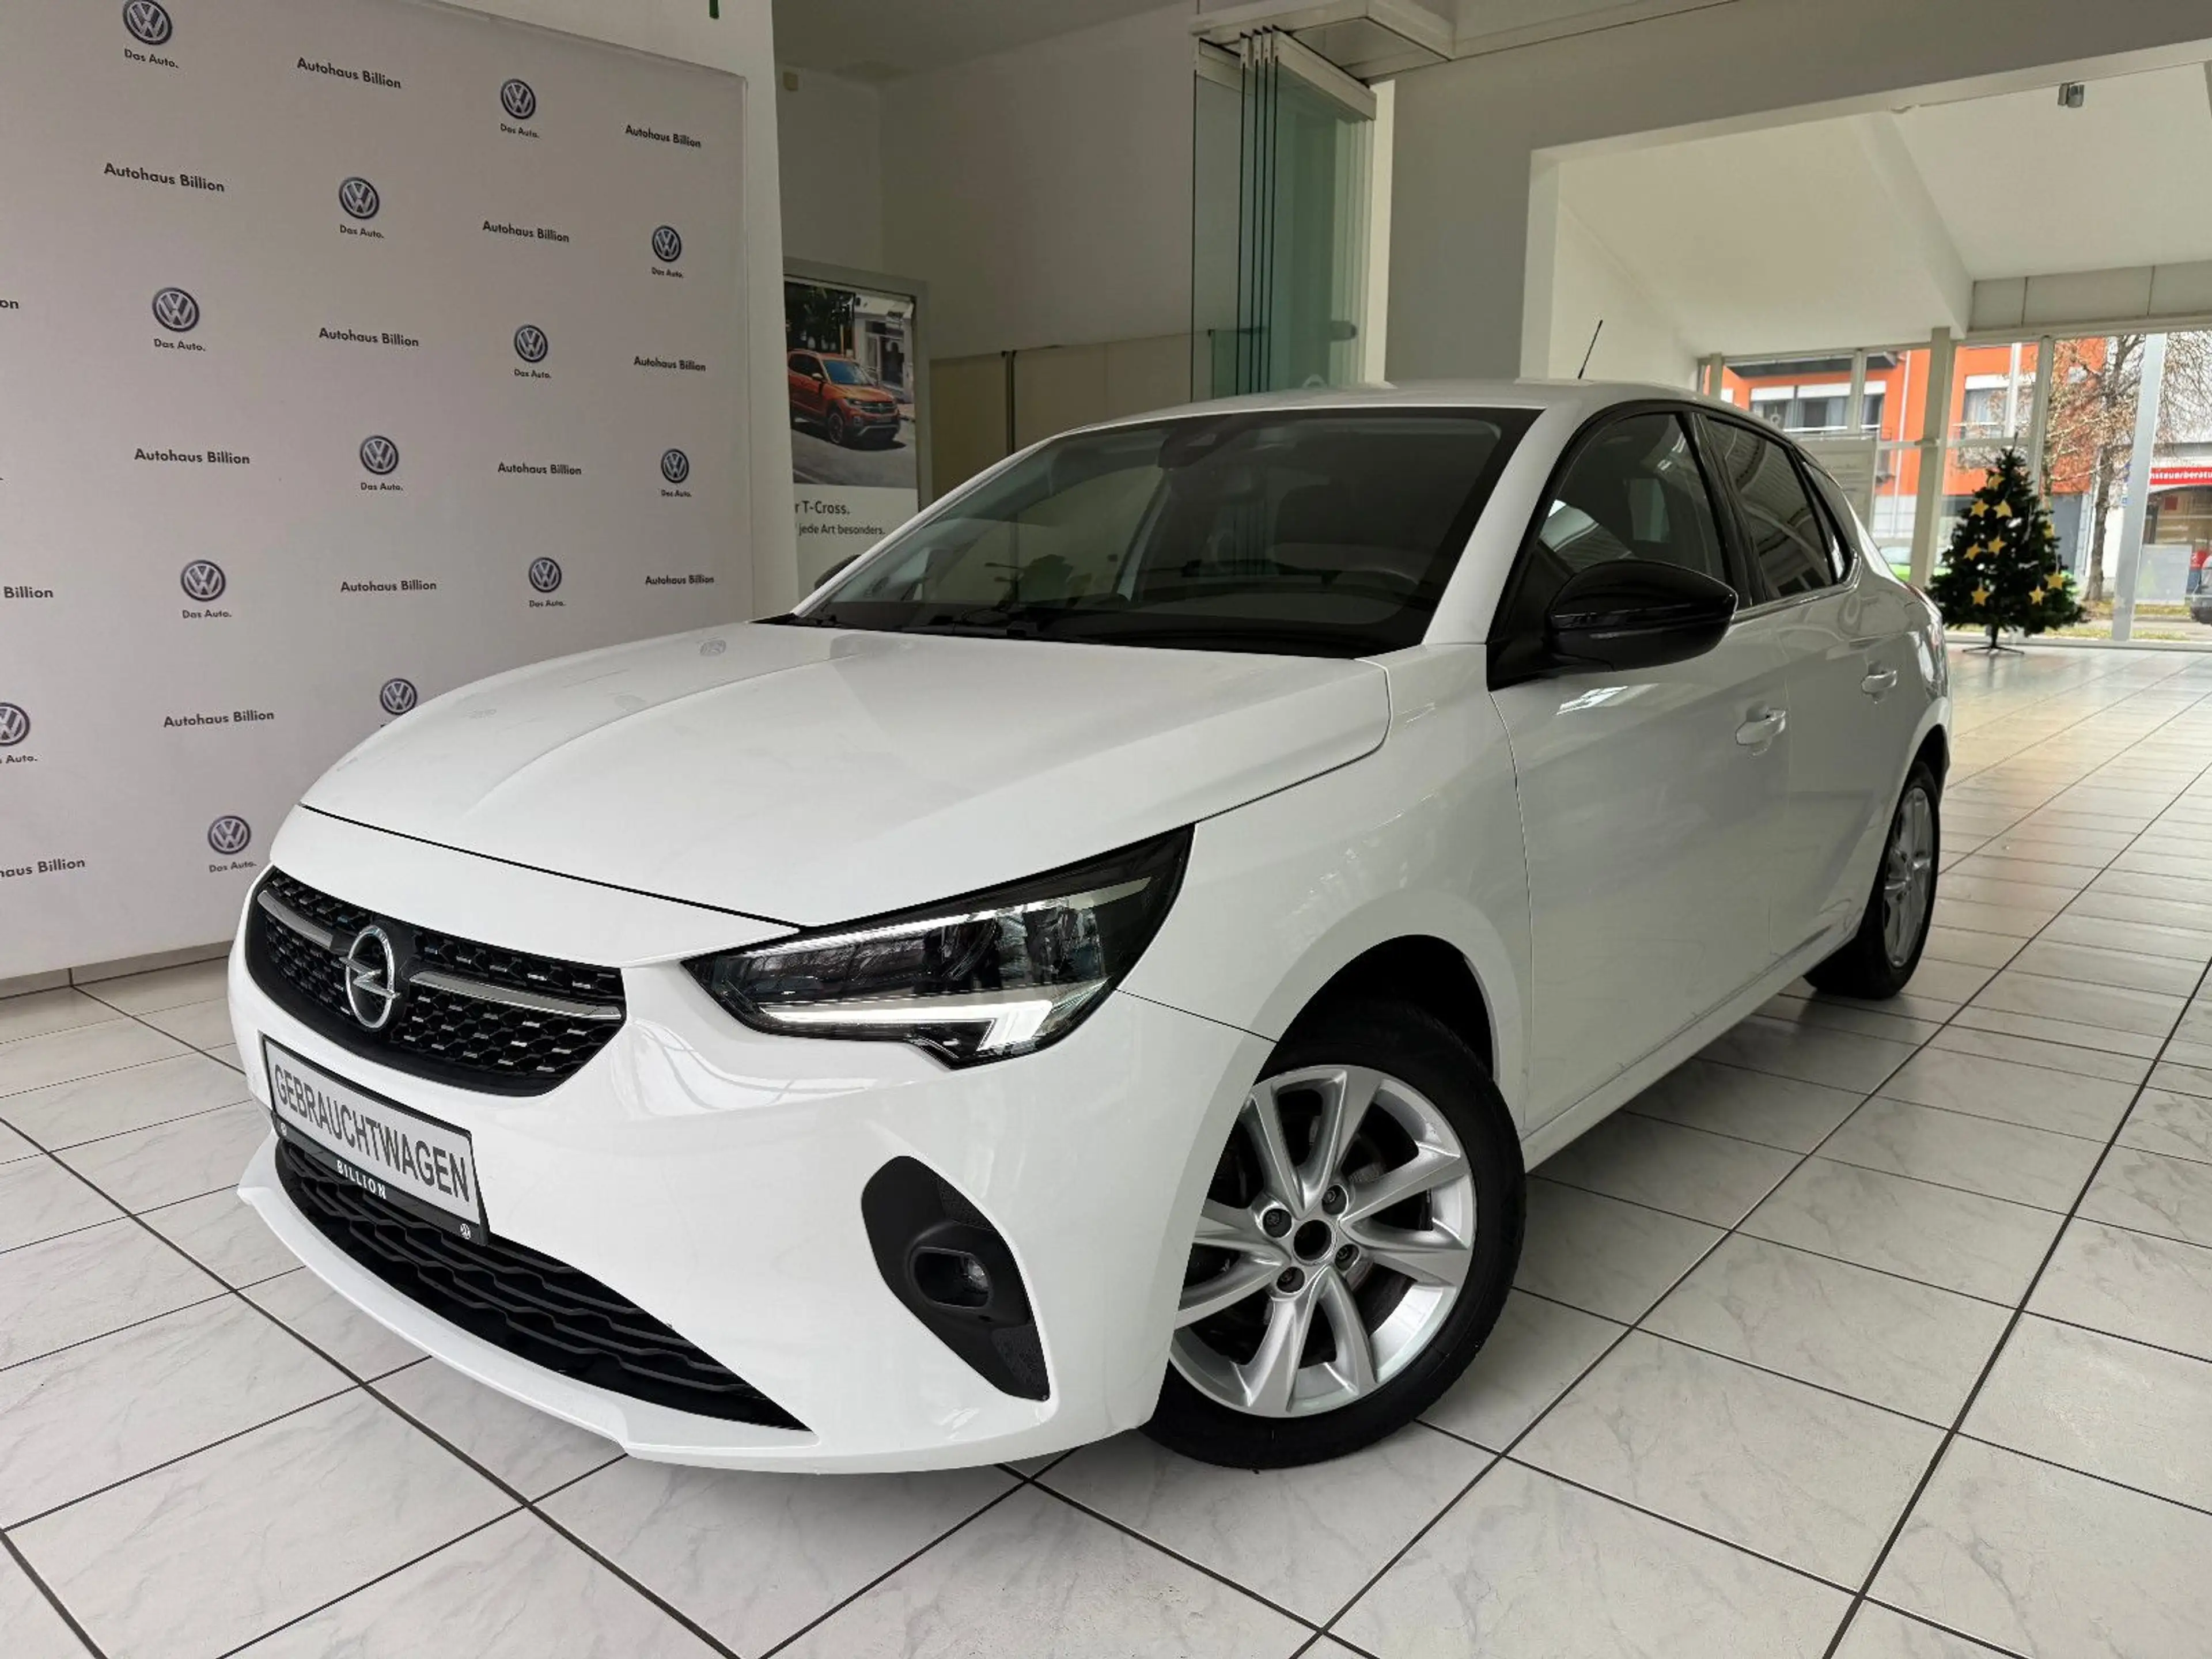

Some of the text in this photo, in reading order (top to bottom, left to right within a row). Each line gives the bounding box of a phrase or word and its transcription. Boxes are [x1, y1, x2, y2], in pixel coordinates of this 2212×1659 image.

[125, 2, 171, 43] VW
[124, 48, 179, 69] Das Auto.
[297, 57, 401, 89] Autohaus Billion
[502, 81, 535, 118] VW
[500, 123, 538, 138] Das Auto.
[625, 124, 701, 148] Autohaus Billion
[104, 162, 225, 192] Autohaus Billion
[341, 179, 377, 218] VW
[340, 224, 384, 238] Das Auto.
[482, 220, 569, 243] Autohaus Billion
[653, 228, 680, 261] VW
[154, 290, 198, 331] VW
[154, 338, 206, 352] Das Auto.
[319, 327, 419, 346] Autohaus Billion
[516, 327, 547, 361] VW
[514, 369, 551, 378] Das Auto.
[633, 356, 706, 372] Autohaus Billion
[134, 448, 250, 464] Autohaus Billion
[361, 437, 397, 474] VW
[497, 462, 582, 475] Autohaus Billion
[662, 450, 688, 482] VW
[361, 482, 403, 491] Das Auto.
[801, 500, 851, 514] T-Cross.
[798, 522, 886, 536] jede Art besonders.
[183, 562, 224, 600] VW
[530, 559, 560, 592] VW
[645, 574, 714, 585] Autohaus Billion
[3, 586, 54, 599] Billion
[340, 579, 437, 592] Autohaus Billion
[529, 600, 544, 608] Das
[182, 609, 232, 619] Das Auto.
[381, 680, 416, 714] VW
[164, 709, 274, 728] Autohaus Billion
[5, 755, 38, 764] Auto.
[210, 817, 249, 854] VW
[37, 858, 85, 873] Billion
[209, 861, 257, 873] Das Auto.
[275, 1064, 470, 1203] GEBRAUCHTWAGEN
[336, 1159, 387, 1199] BILLION
